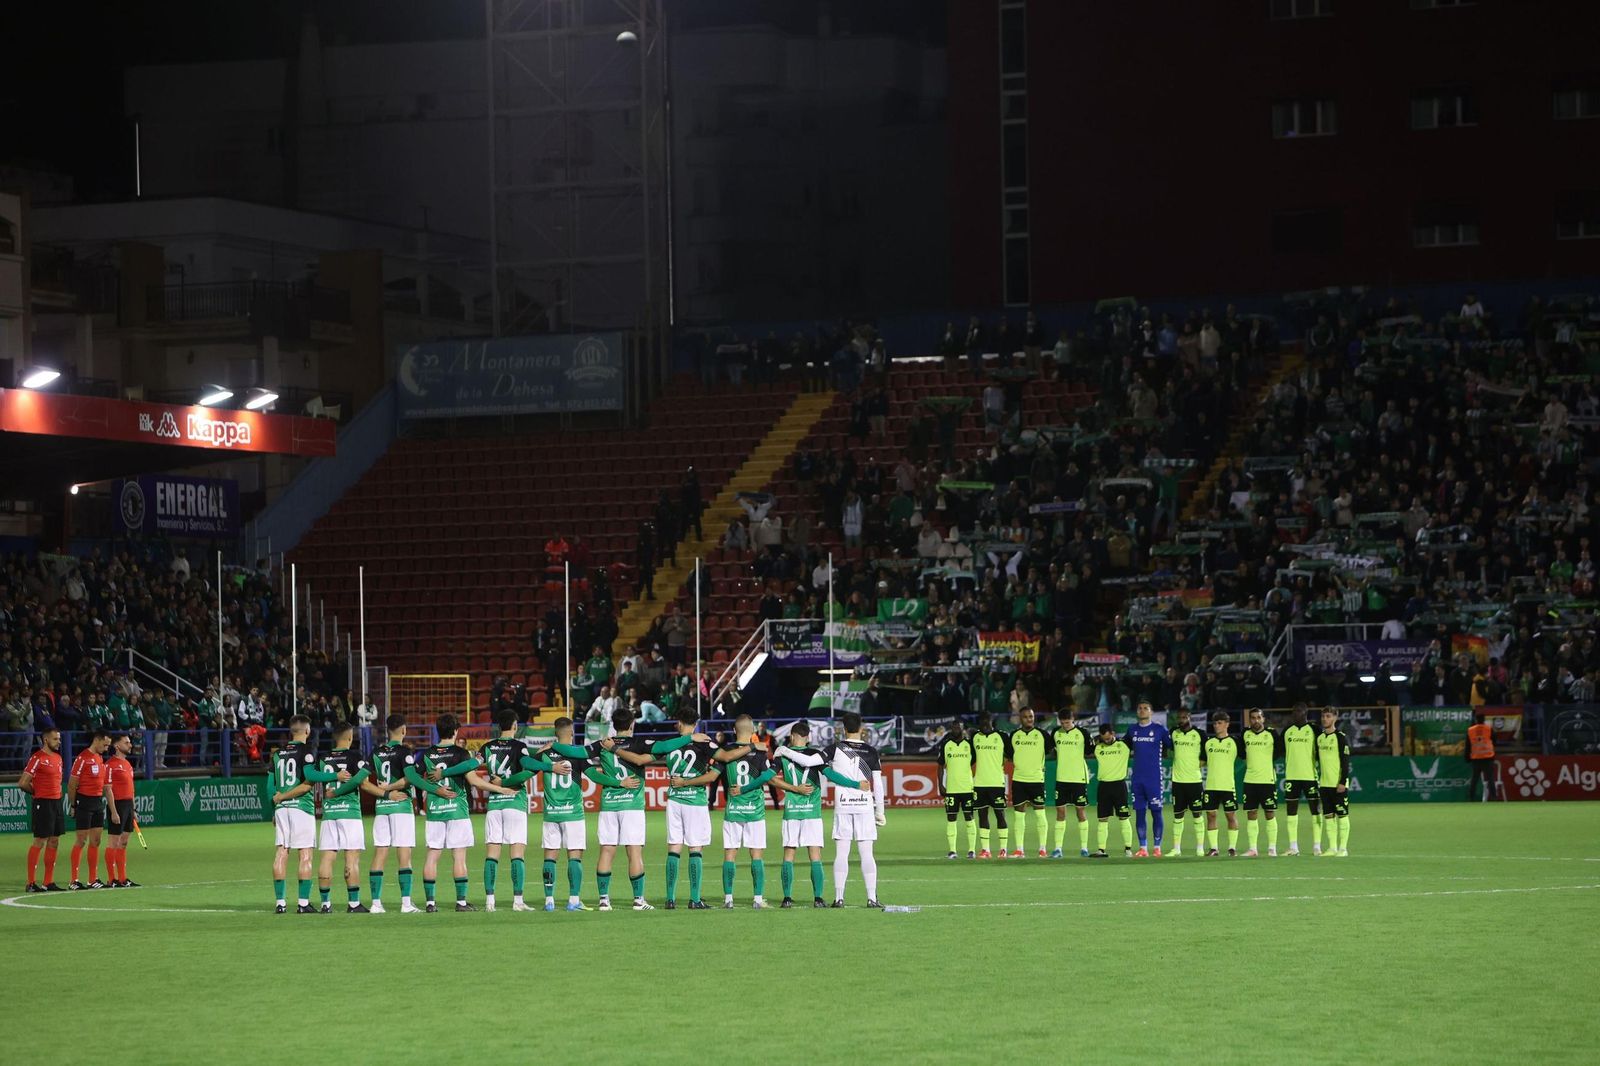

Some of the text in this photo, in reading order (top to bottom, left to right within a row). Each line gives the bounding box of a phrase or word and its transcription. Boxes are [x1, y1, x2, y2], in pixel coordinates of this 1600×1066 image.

[187, 413, 252, 448] Kappa
[156, 481, 228, 518] ENERGAL
[277, 758, 297, 787] 19
[381, 761, 391, 787] 9
[487, 753, 512, 779] 14
[551, 760, 573, 789] 10
[670, 749, 697, 777] 22
[736, 761, 750, 787] 8
[1557, 763, 1600, 791] Alg
[200, 784, 258, 799] CAJA RURAL DE
[200, 797, 262, 811] EXTREMADURA
